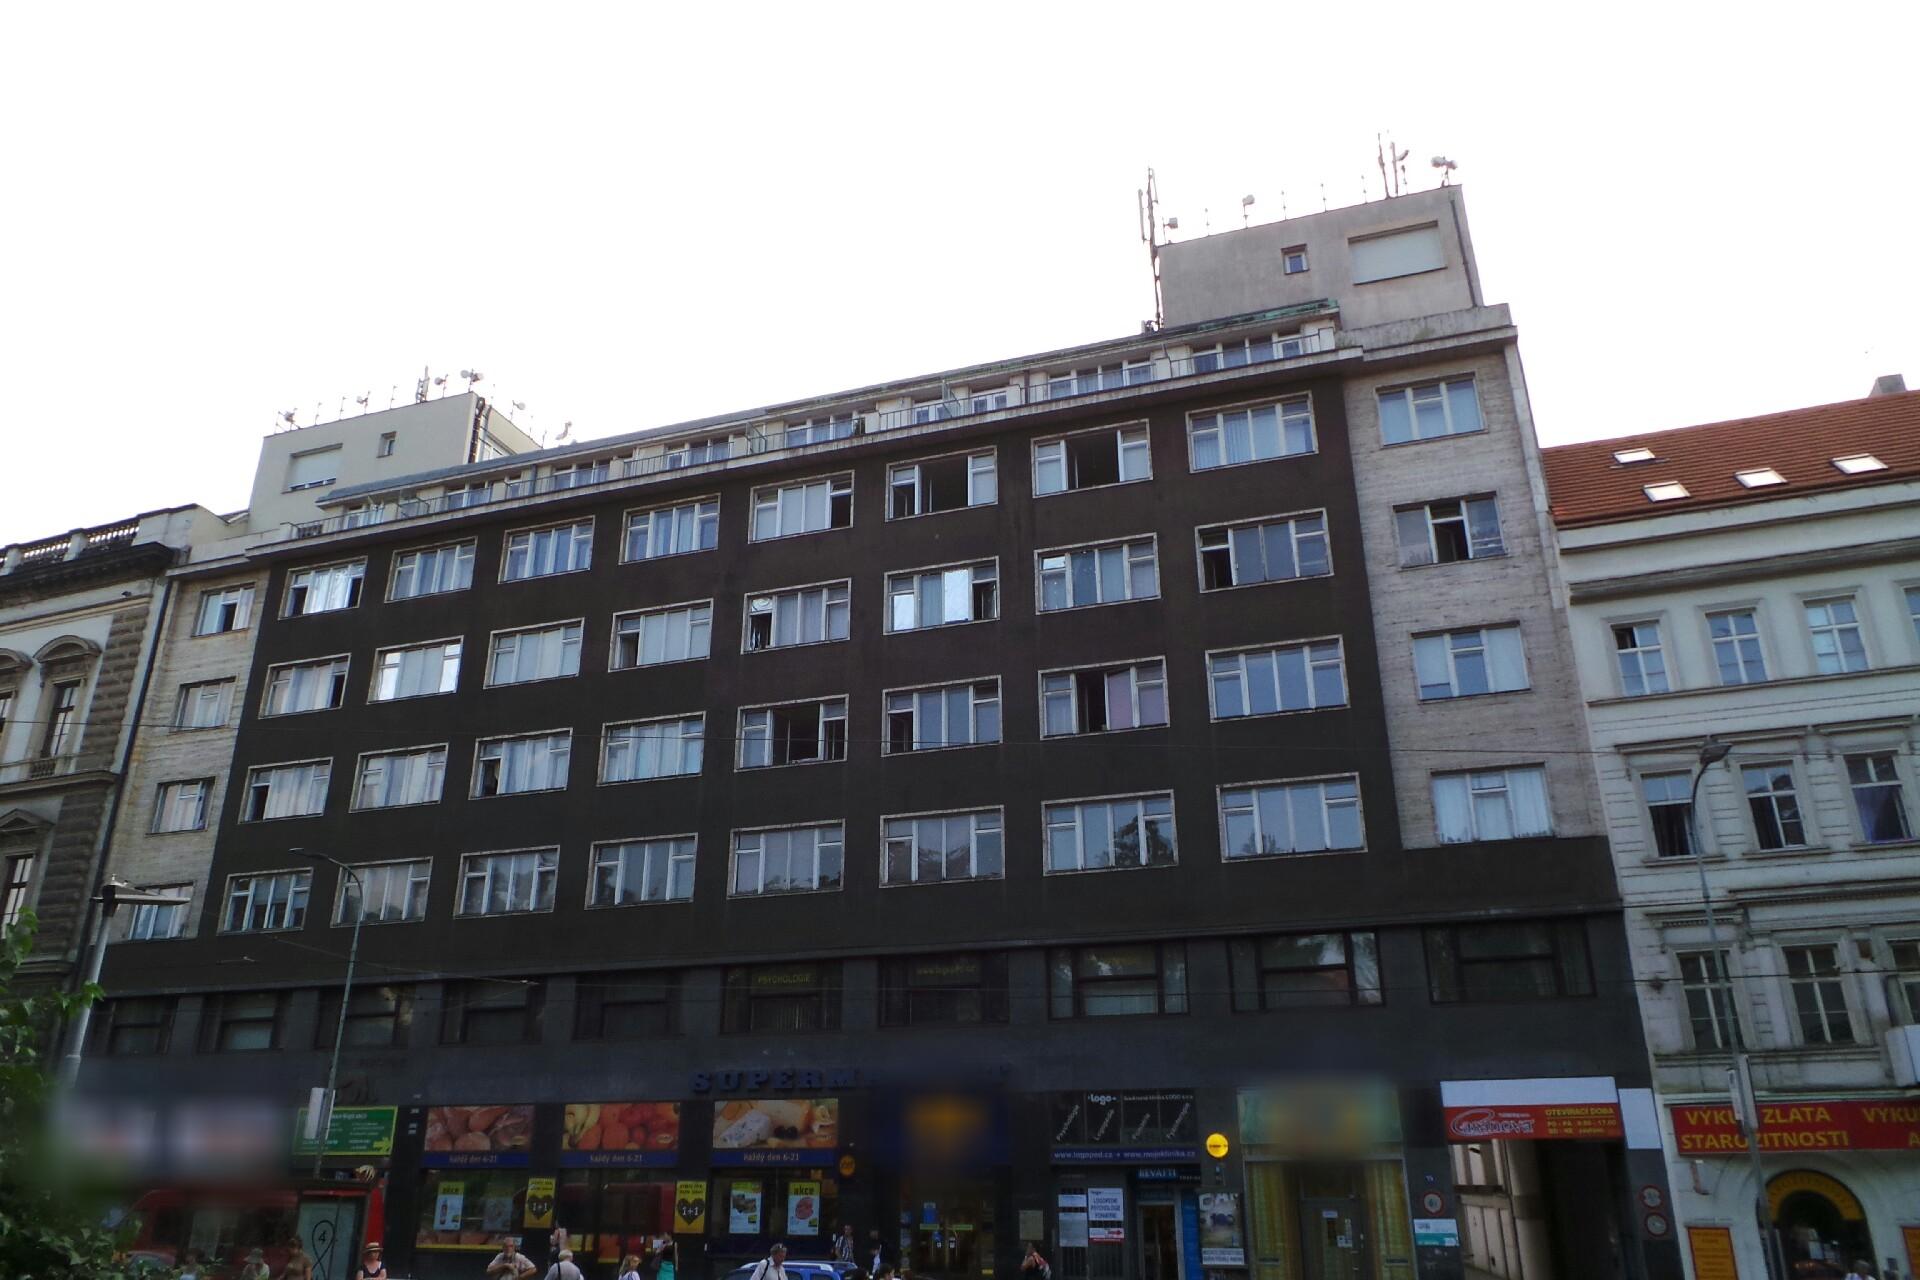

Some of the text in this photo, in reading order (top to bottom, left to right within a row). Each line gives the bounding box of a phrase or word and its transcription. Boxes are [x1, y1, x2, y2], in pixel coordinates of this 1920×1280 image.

[1761, 1106, 1832, 1123] ZLATA
[794, 1185, 815, 1196] akce
[682, 1206, 698, 1216] 1+1
